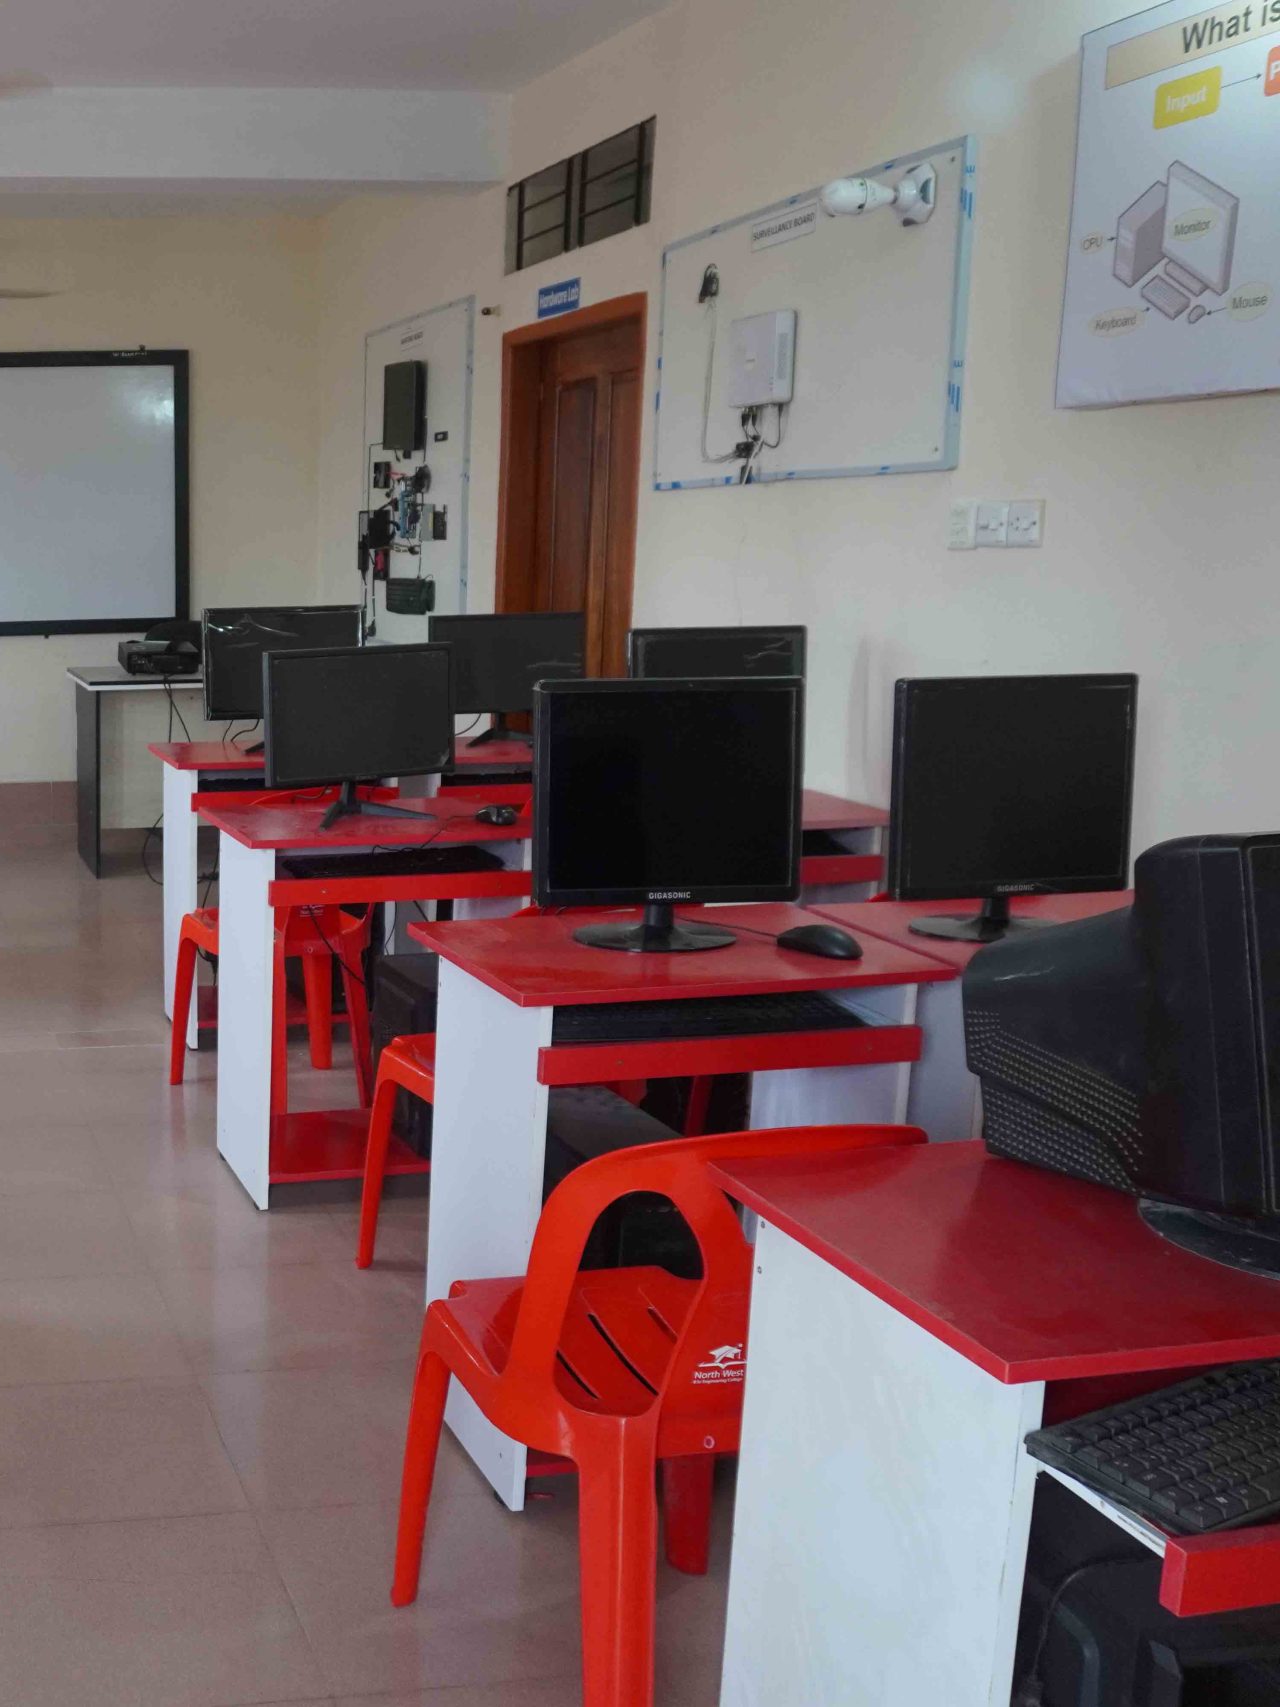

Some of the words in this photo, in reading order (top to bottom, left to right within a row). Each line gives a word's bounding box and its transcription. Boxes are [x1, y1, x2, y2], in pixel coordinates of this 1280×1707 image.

[1182, 4, 1253, 54] What
[1166, 85, 1208, 113] Input
[1173, 219, 1212, 237] Monitor
[1082, 237, 1104, 251] CPU
[1231, 295, 1269, 310] Mouse
[1094, 314, 1138, 332] Keyboard
[648, 891, 691, 900] GIGASONIC
[694, 1371, 721, 1379] North
[721, 1369, 744, 1377] West
